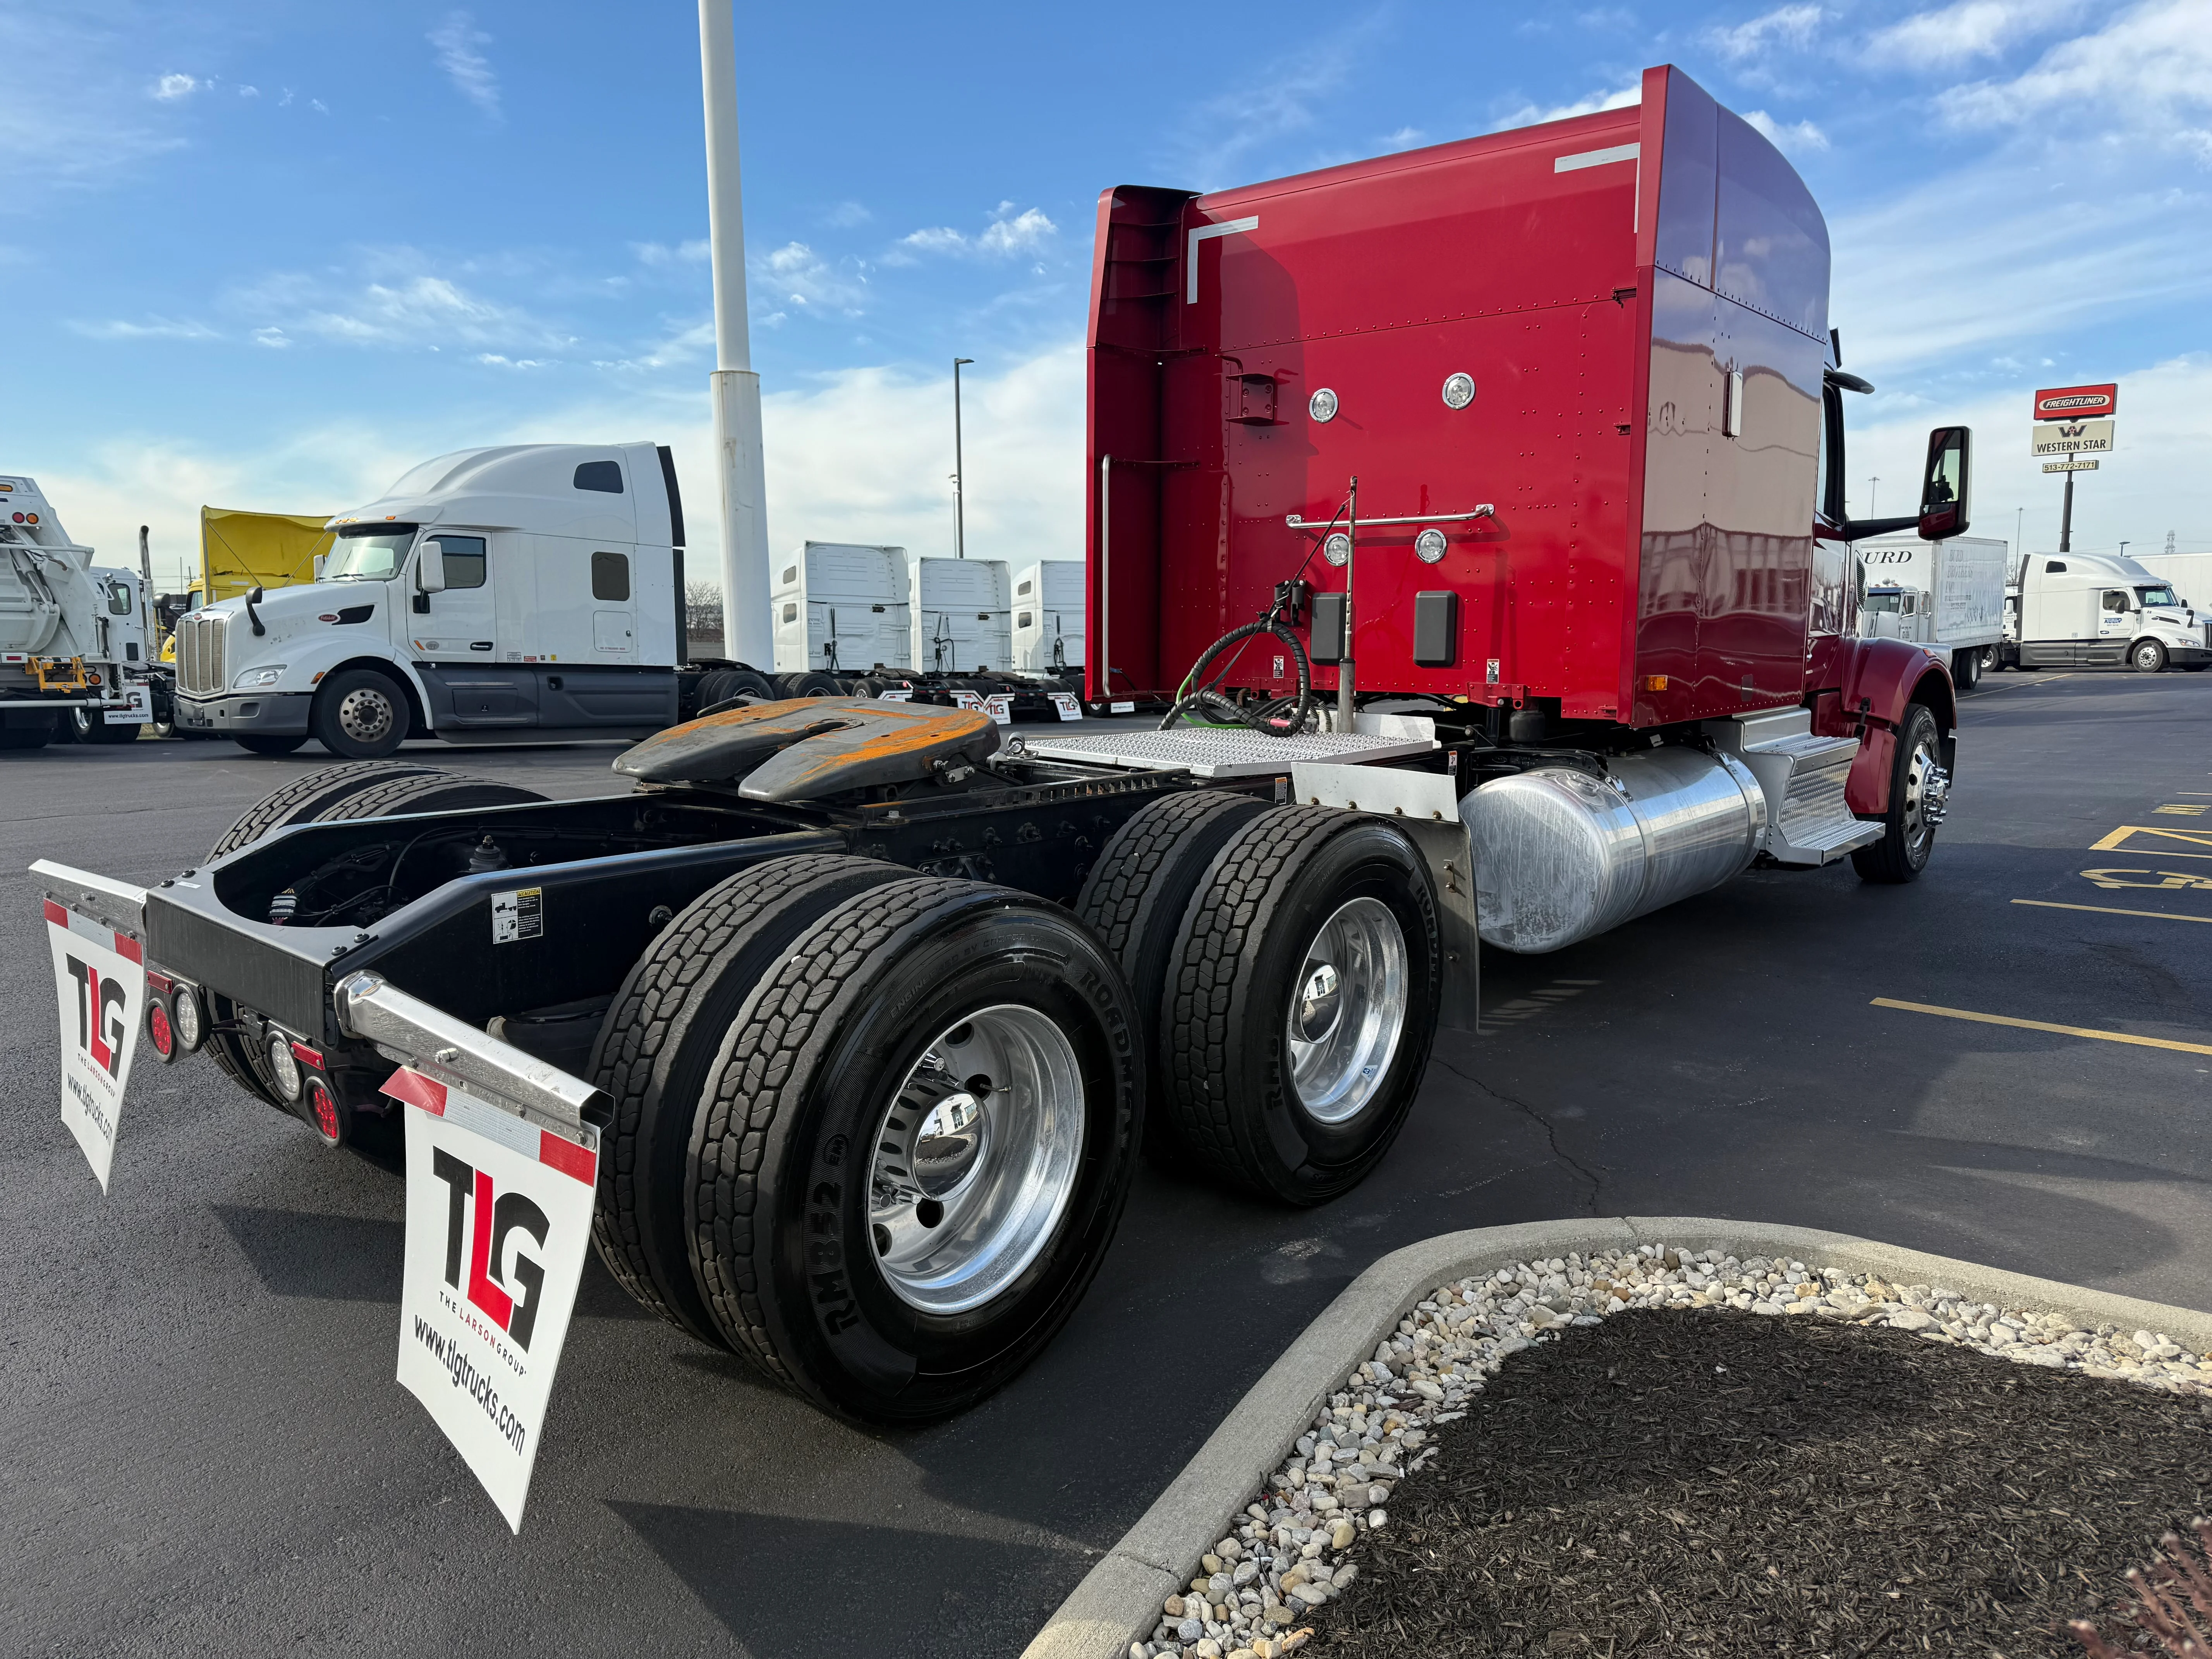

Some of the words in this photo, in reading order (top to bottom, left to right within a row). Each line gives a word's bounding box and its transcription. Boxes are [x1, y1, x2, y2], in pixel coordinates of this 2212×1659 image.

[2045, 397, 2104, 408] FREIGHTLINER
[2037, 441, 2080, 453] WESTERN
[2083, 439, 2106, 450] STAR
[2044, 462, 2094, 471] 513-772-7171
[1864, 551, 1912, 564] URD
[1949, 550, 1963, 562] BURD
[1947, 565, 1973, 578] BROTHERS
[989, 704, 1005, 715] TLG
[1060, 701, 1076, 711] TLG
[65, 952, 127, 1083] TLG
[78, 1053, 86, 1067] THE
[87, 1061, 103, 1084] LARSON
[103, 1080, 115, 1098] GROUP
[68, 1072, 113, 1149] www.tlgtrucks.com
[432, 1145, 550, 1355] TLG
[810, 1181, 859, 1337] RM852
[440, 1290, 457, 1314] THE
[459, 1307, 496, 1349] LARSON
[497, 1343, 524, 1377] GROUP
[414, 1314, 526, 1457] www.tlgtrucks.com
